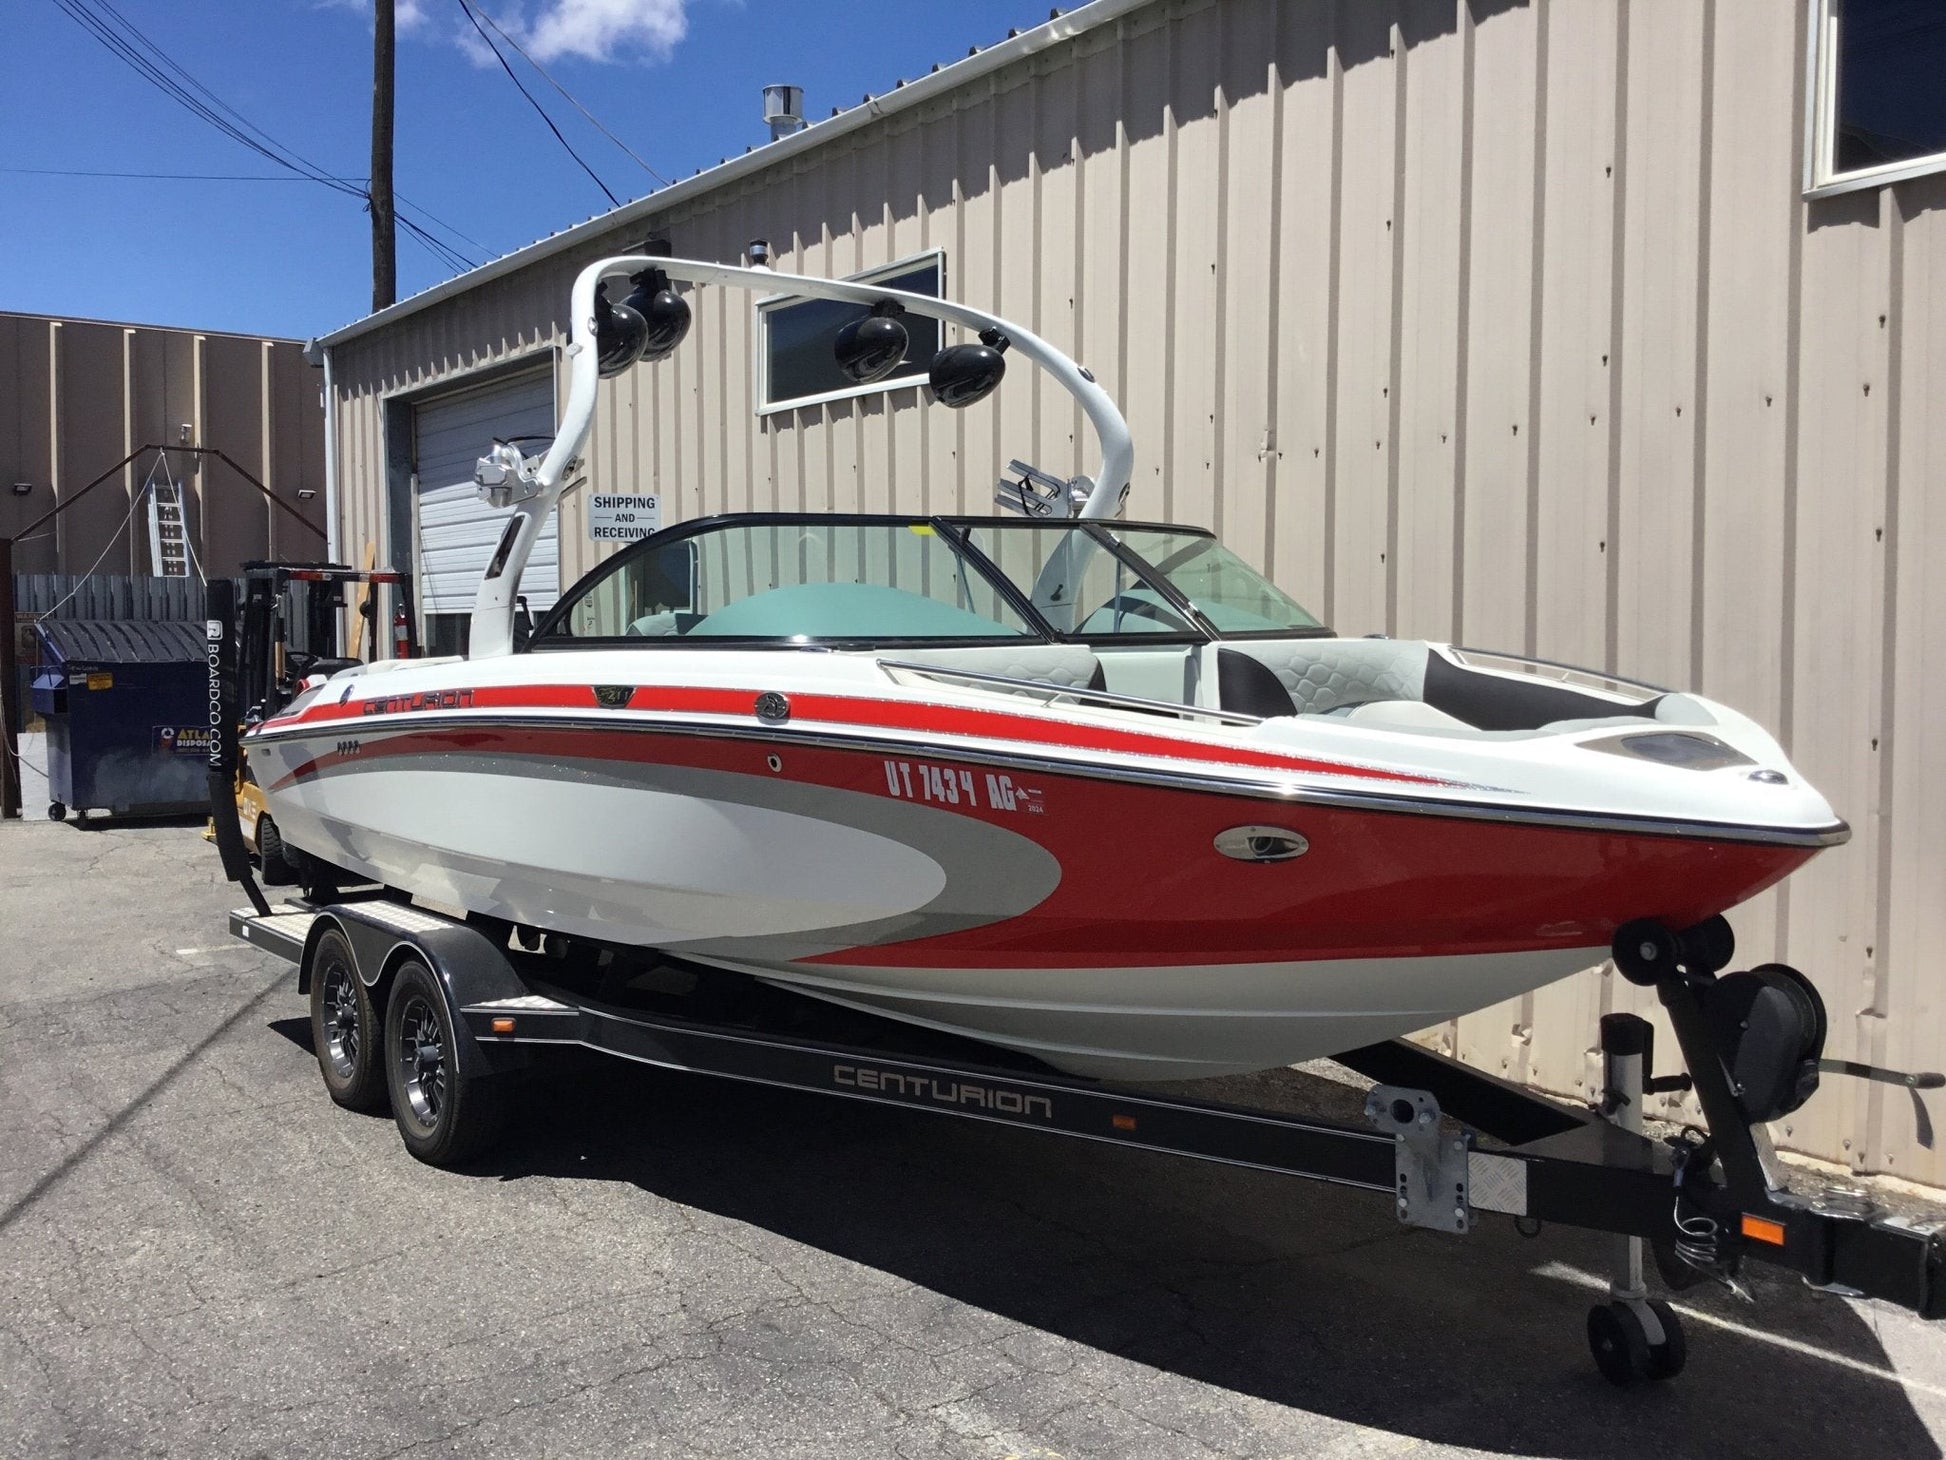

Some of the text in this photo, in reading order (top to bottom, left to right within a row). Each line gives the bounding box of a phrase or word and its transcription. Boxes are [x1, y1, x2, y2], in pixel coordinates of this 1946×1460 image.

[594, 496, 655, 509] SHIPPING
[614, 513, 636, 523] AND
[594, 526, 656, 538] RECEIVING
[207, 643, 222, 767] BOARDCO.COM
[177, 728, 210, 740] ATLA
[884, 760, 1017, 812] UT 7434 AG
[833, 1064, 1052, 1119] CENTURION
